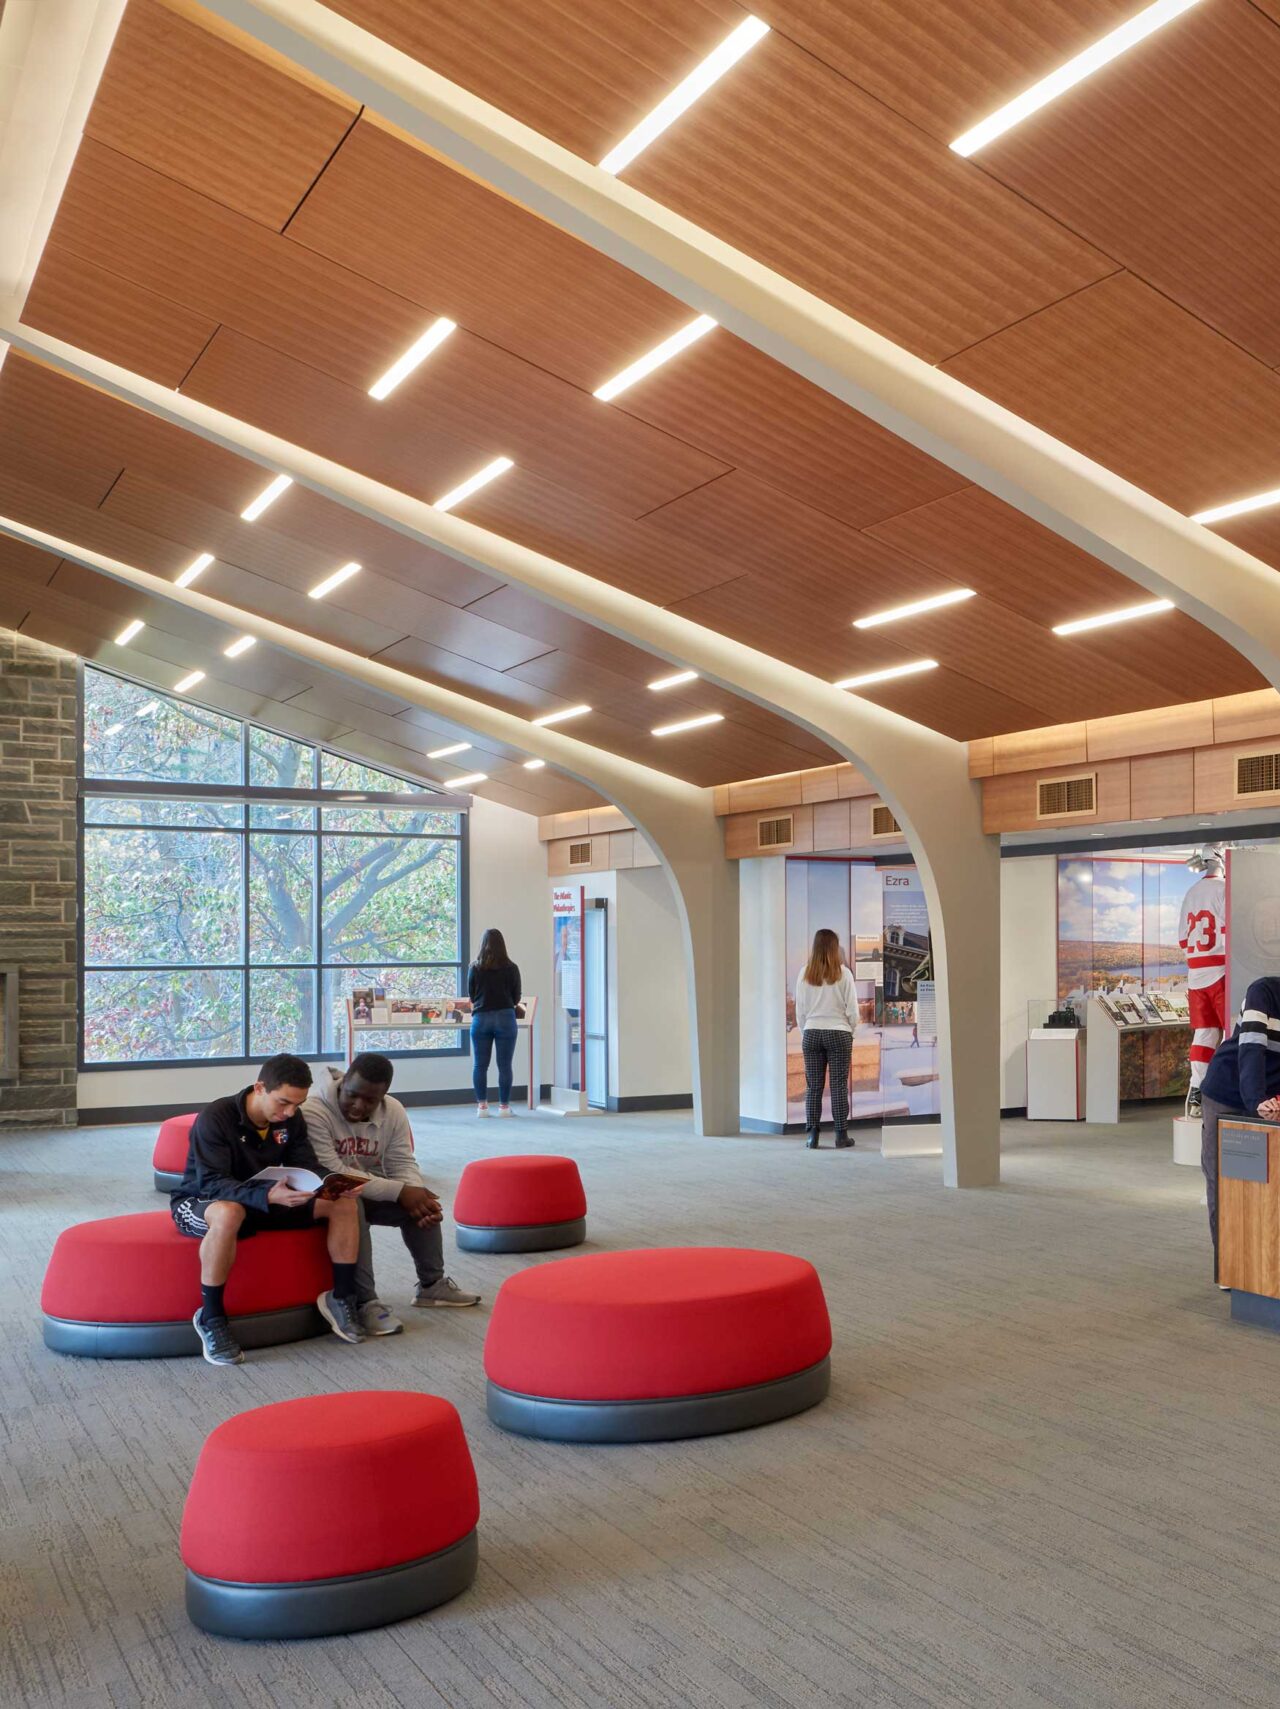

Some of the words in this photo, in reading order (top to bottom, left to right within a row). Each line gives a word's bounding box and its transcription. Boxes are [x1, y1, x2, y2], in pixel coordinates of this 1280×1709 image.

[885, 875, 910, 886] Ezra
[1186, 910, 1217, 954] 23
[335, 1136, 379, 1156] CORELL
